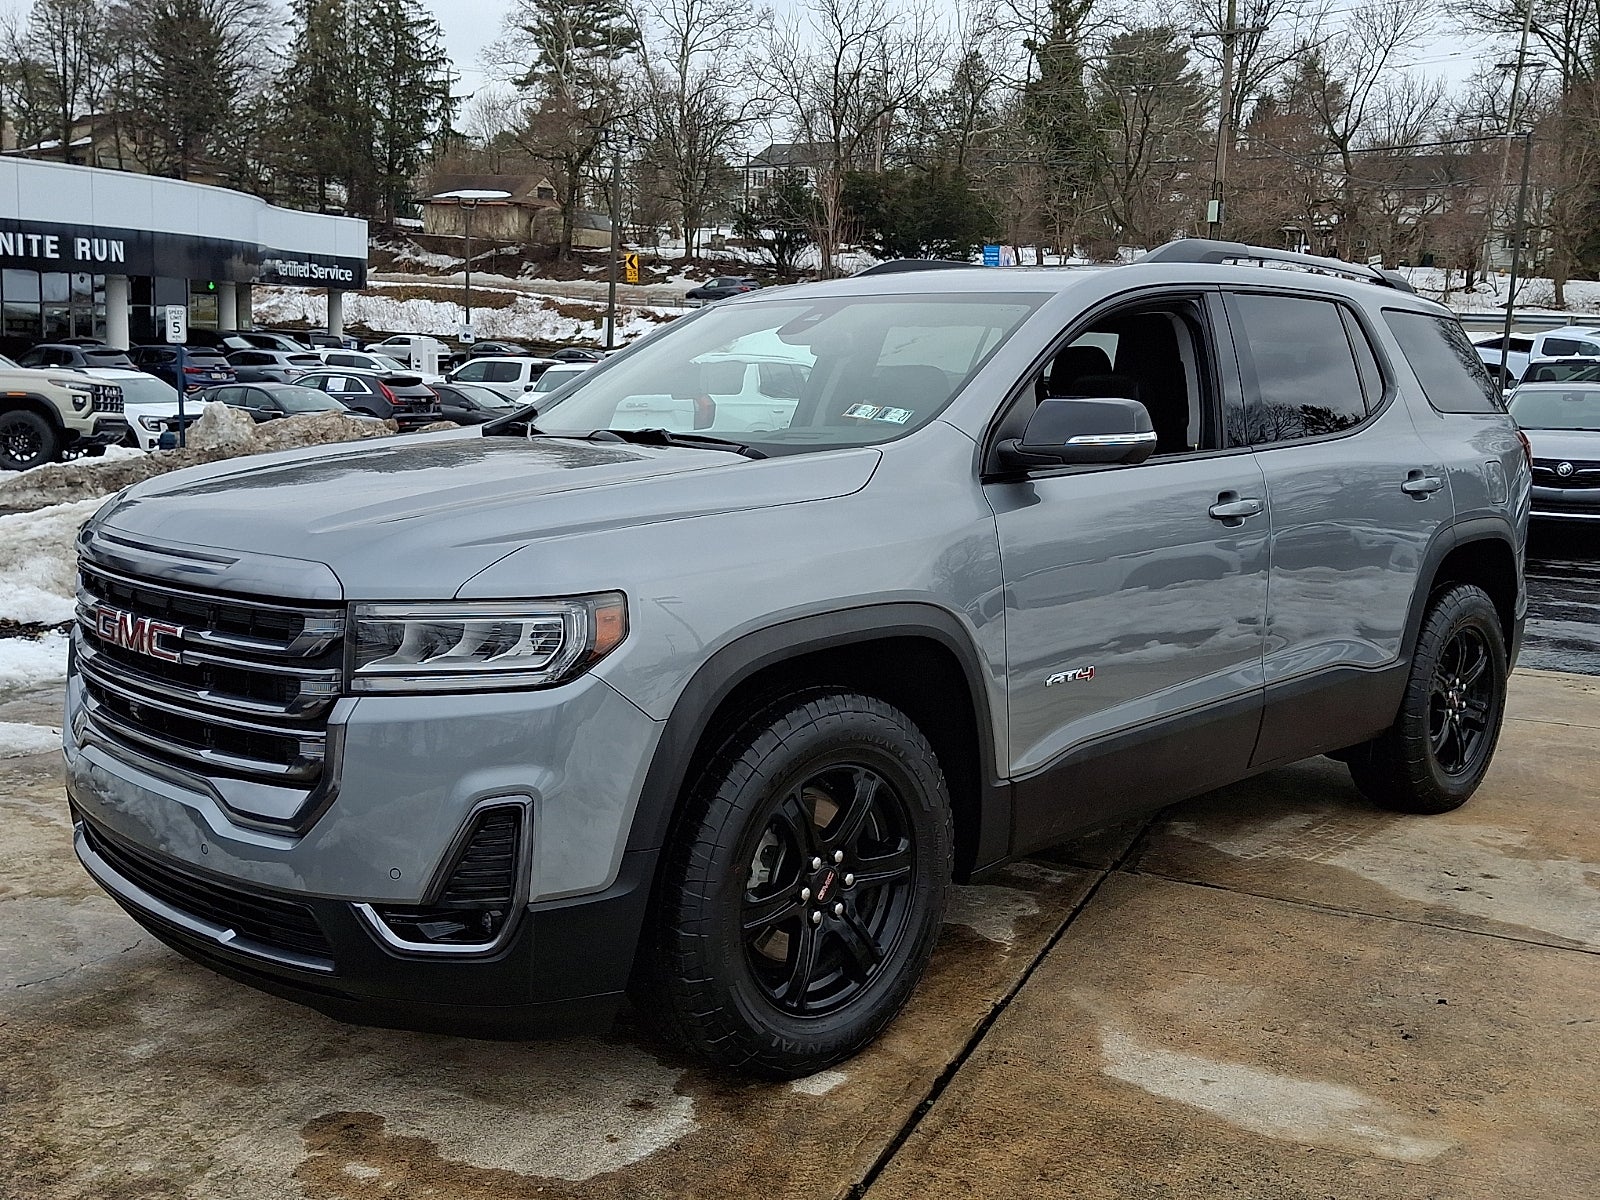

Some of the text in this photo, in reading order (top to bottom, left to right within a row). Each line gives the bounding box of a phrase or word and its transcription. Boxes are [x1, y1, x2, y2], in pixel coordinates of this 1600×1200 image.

[75, 237, 125, 263] RUN
[278, 260, 353, 281] Certified Service
[172, 321, 181, 334] 5
[96, 605, 184, 664] GMC
[1045, 665, 1095, 687] AT4
[817, 870, 835, 900] GMC
